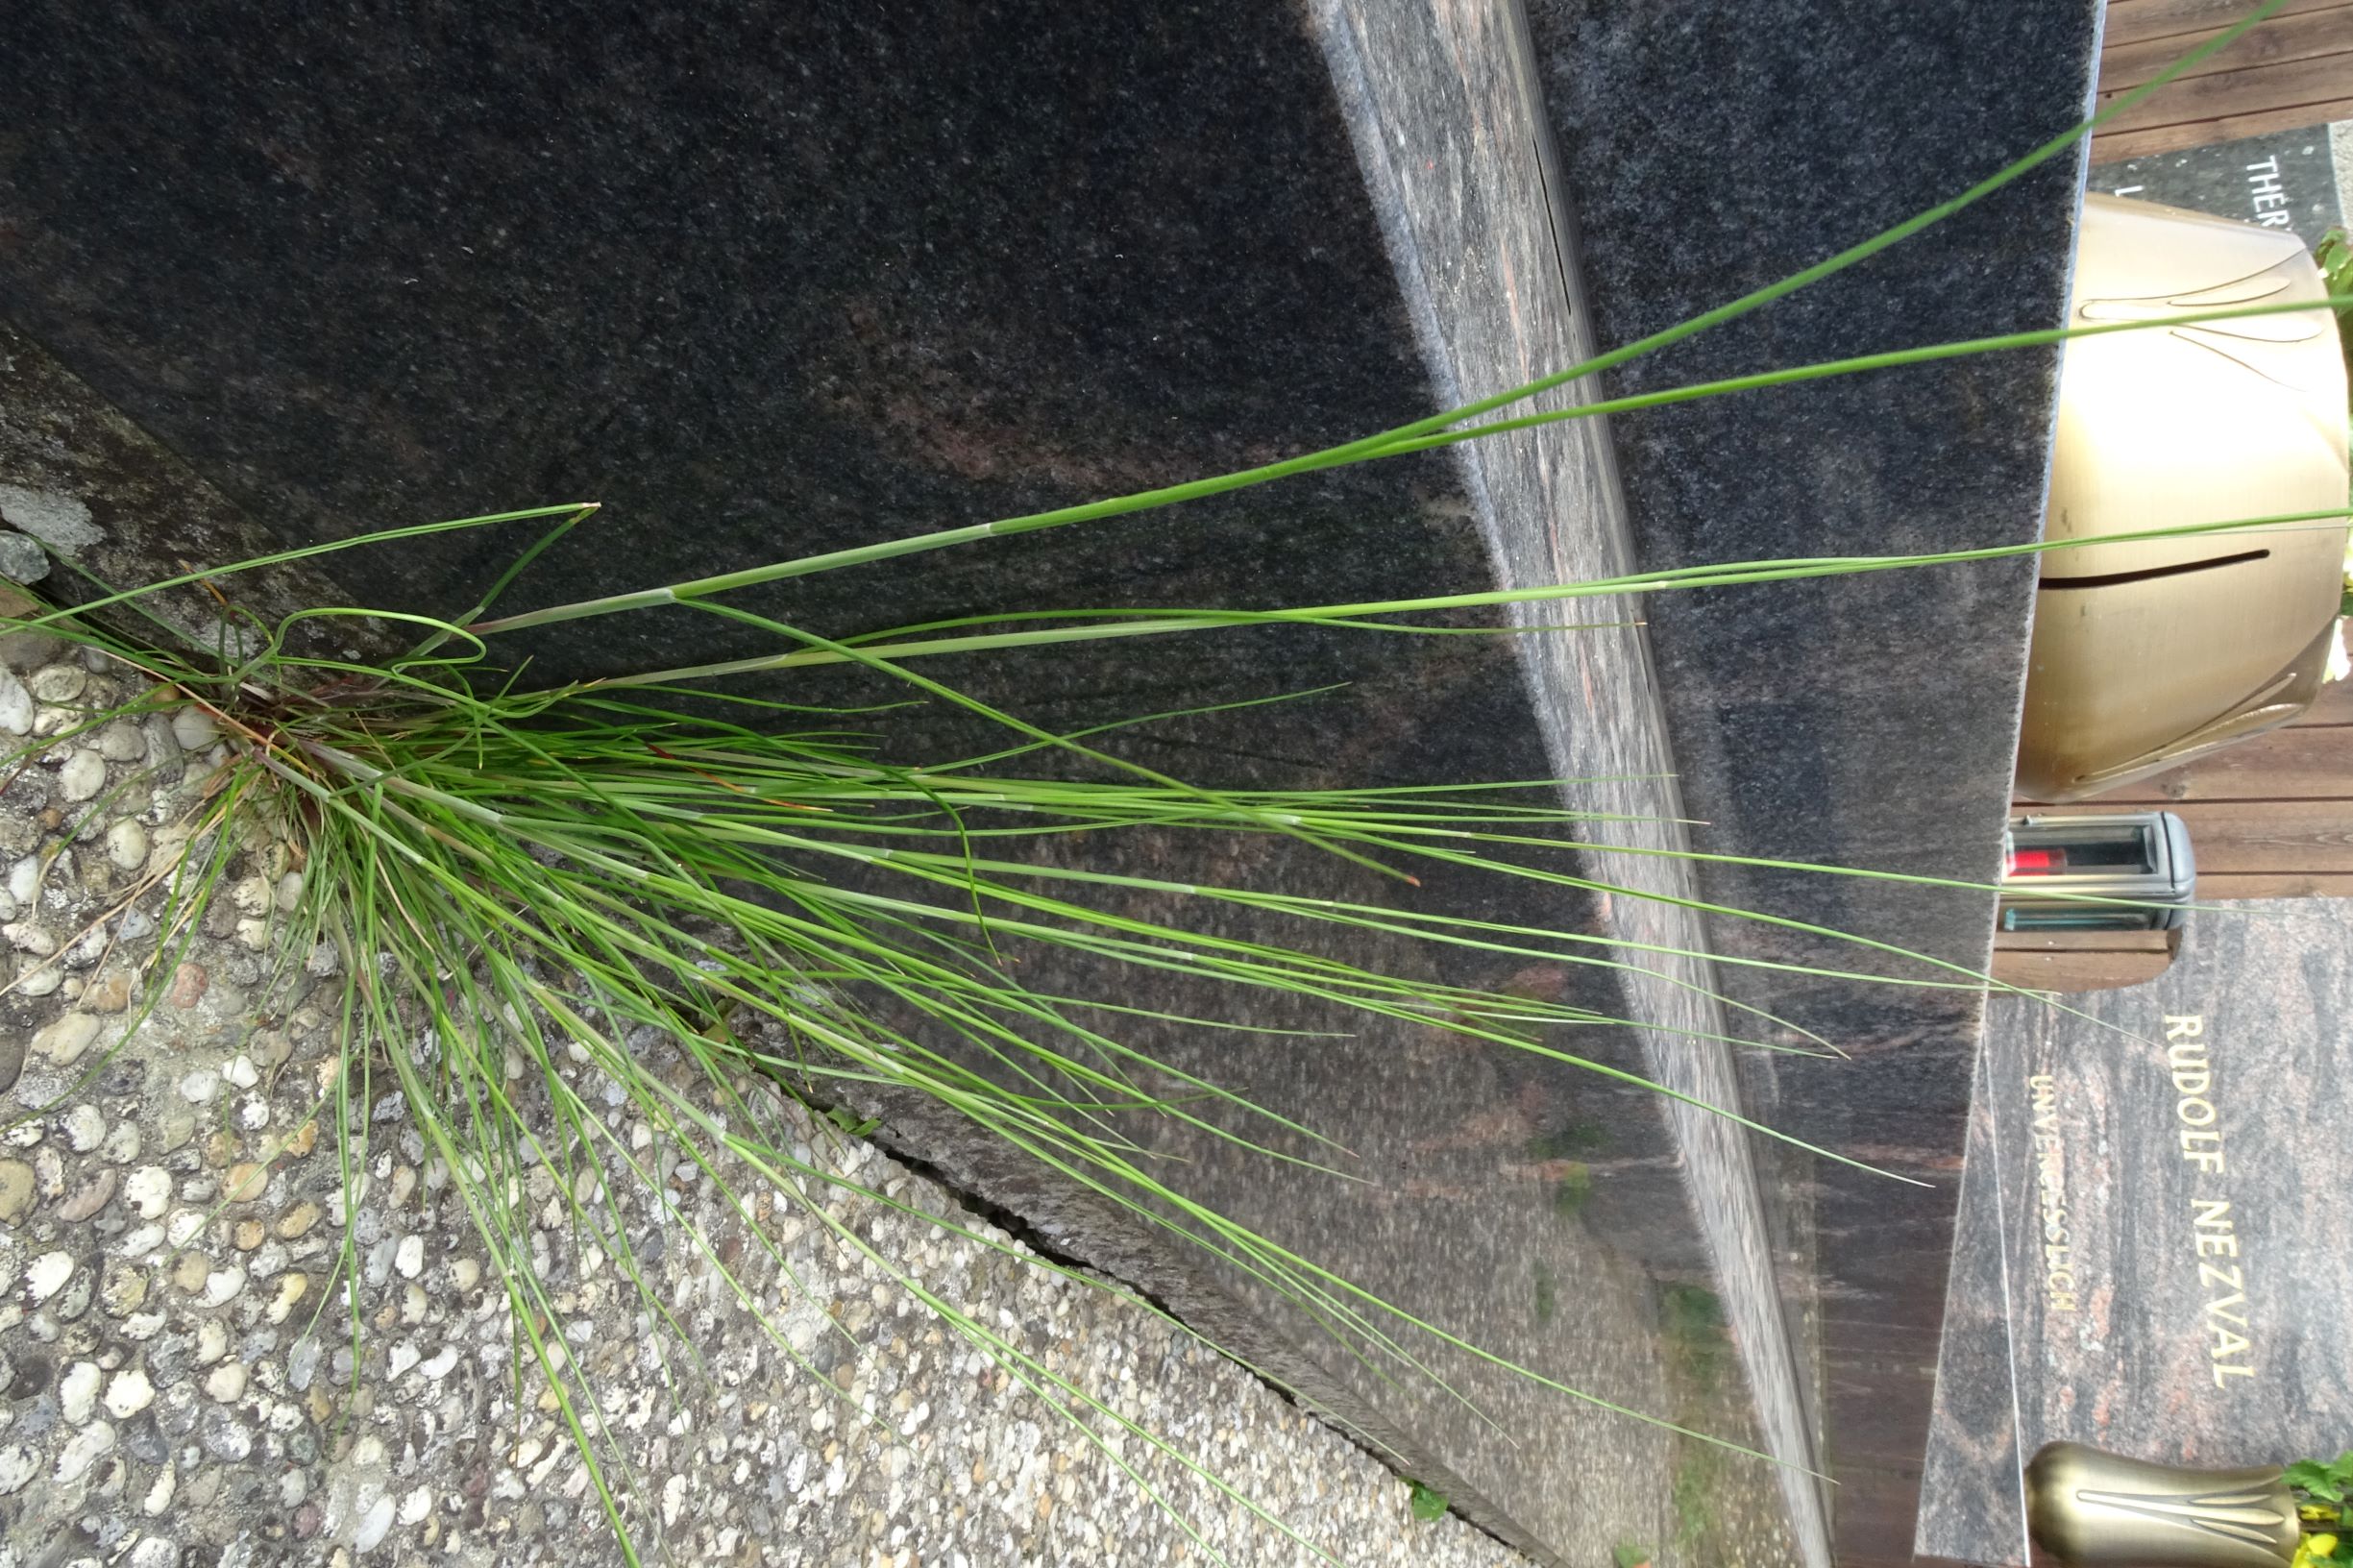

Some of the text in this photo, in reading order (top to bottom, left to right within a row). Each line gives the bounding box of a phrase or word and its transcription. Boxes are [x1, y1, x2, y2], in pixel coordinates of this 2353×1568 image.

[2246, 155, 2292, 232] THER
[2030, 1075, 2076, 1311] UNVERGESSLICH
[2166, 1015, 2254, 1388] RUDOLF NEZVAL
